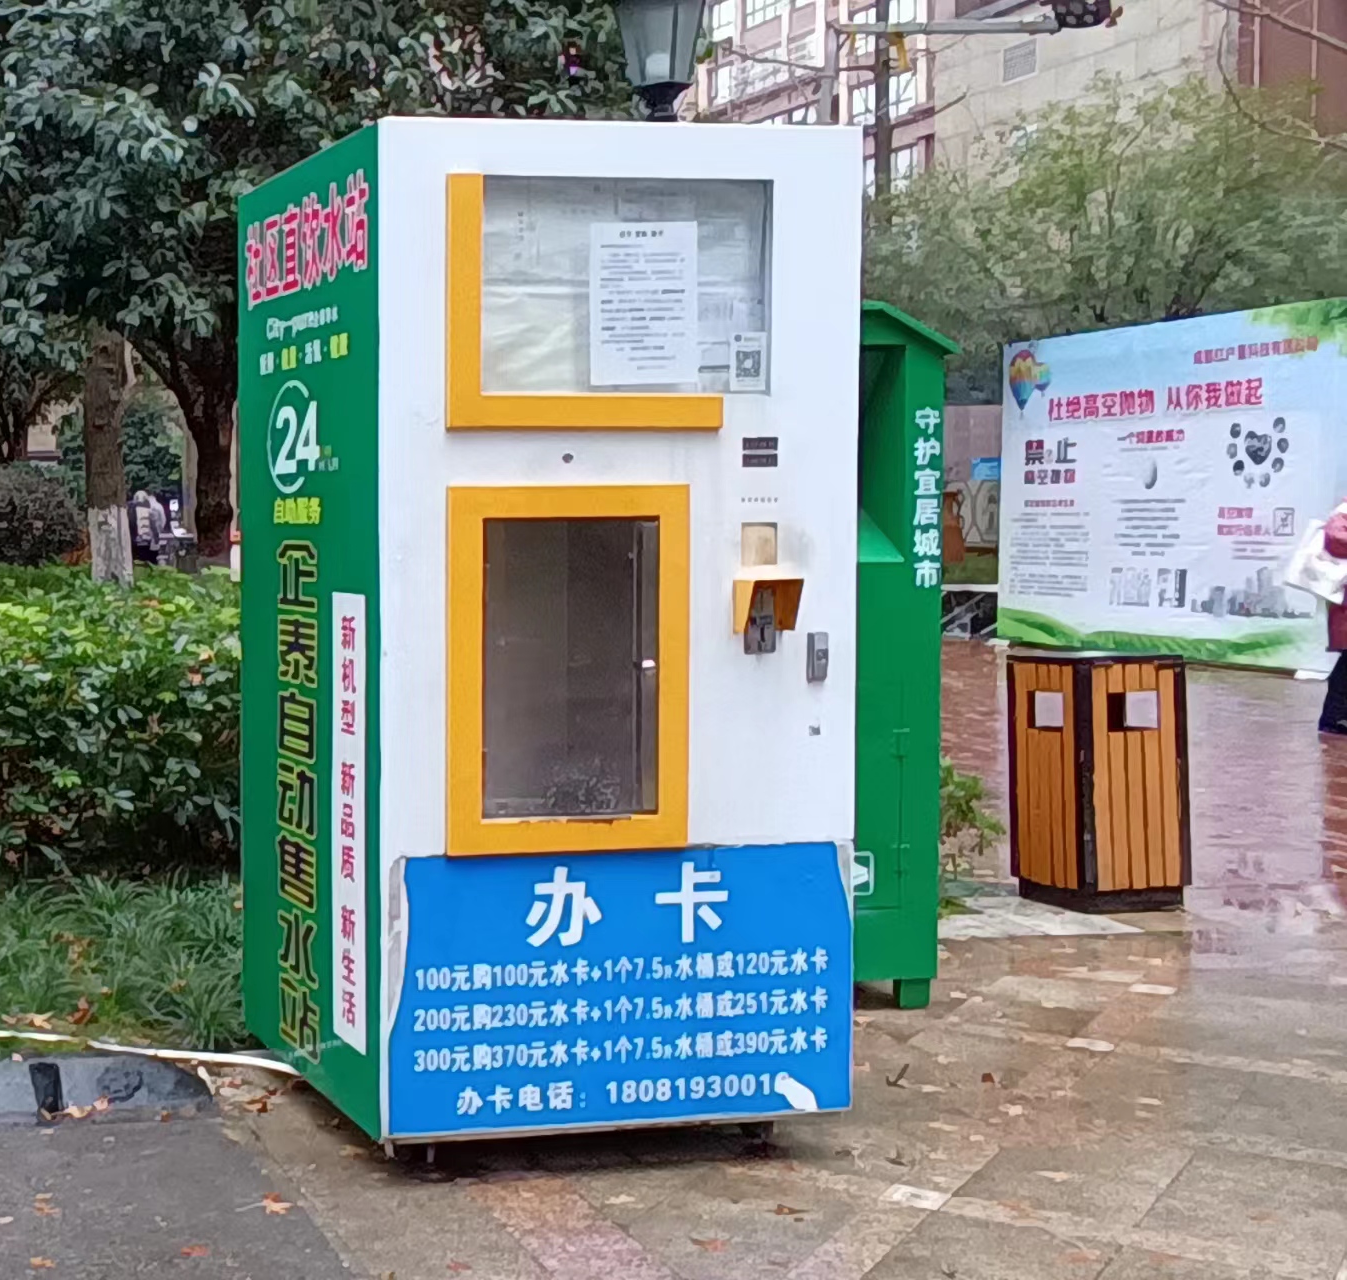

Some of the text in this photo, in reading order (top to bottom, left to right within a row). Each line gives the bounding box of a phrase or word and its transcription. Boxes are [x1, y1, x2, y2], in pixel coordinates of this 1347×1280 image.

[246, 168, 369, 311] 社区直饮水站
[273, 400, 320, 476] 24
[1048, 376, 1263, 422] 杜绝高空抛物 从你我做起
[913, 406, 941, 588] 守护宜居城市
[340, 615, 356, 1030] 新机型 新品质 新生活
[525, 861, 730, 948] 办卡
